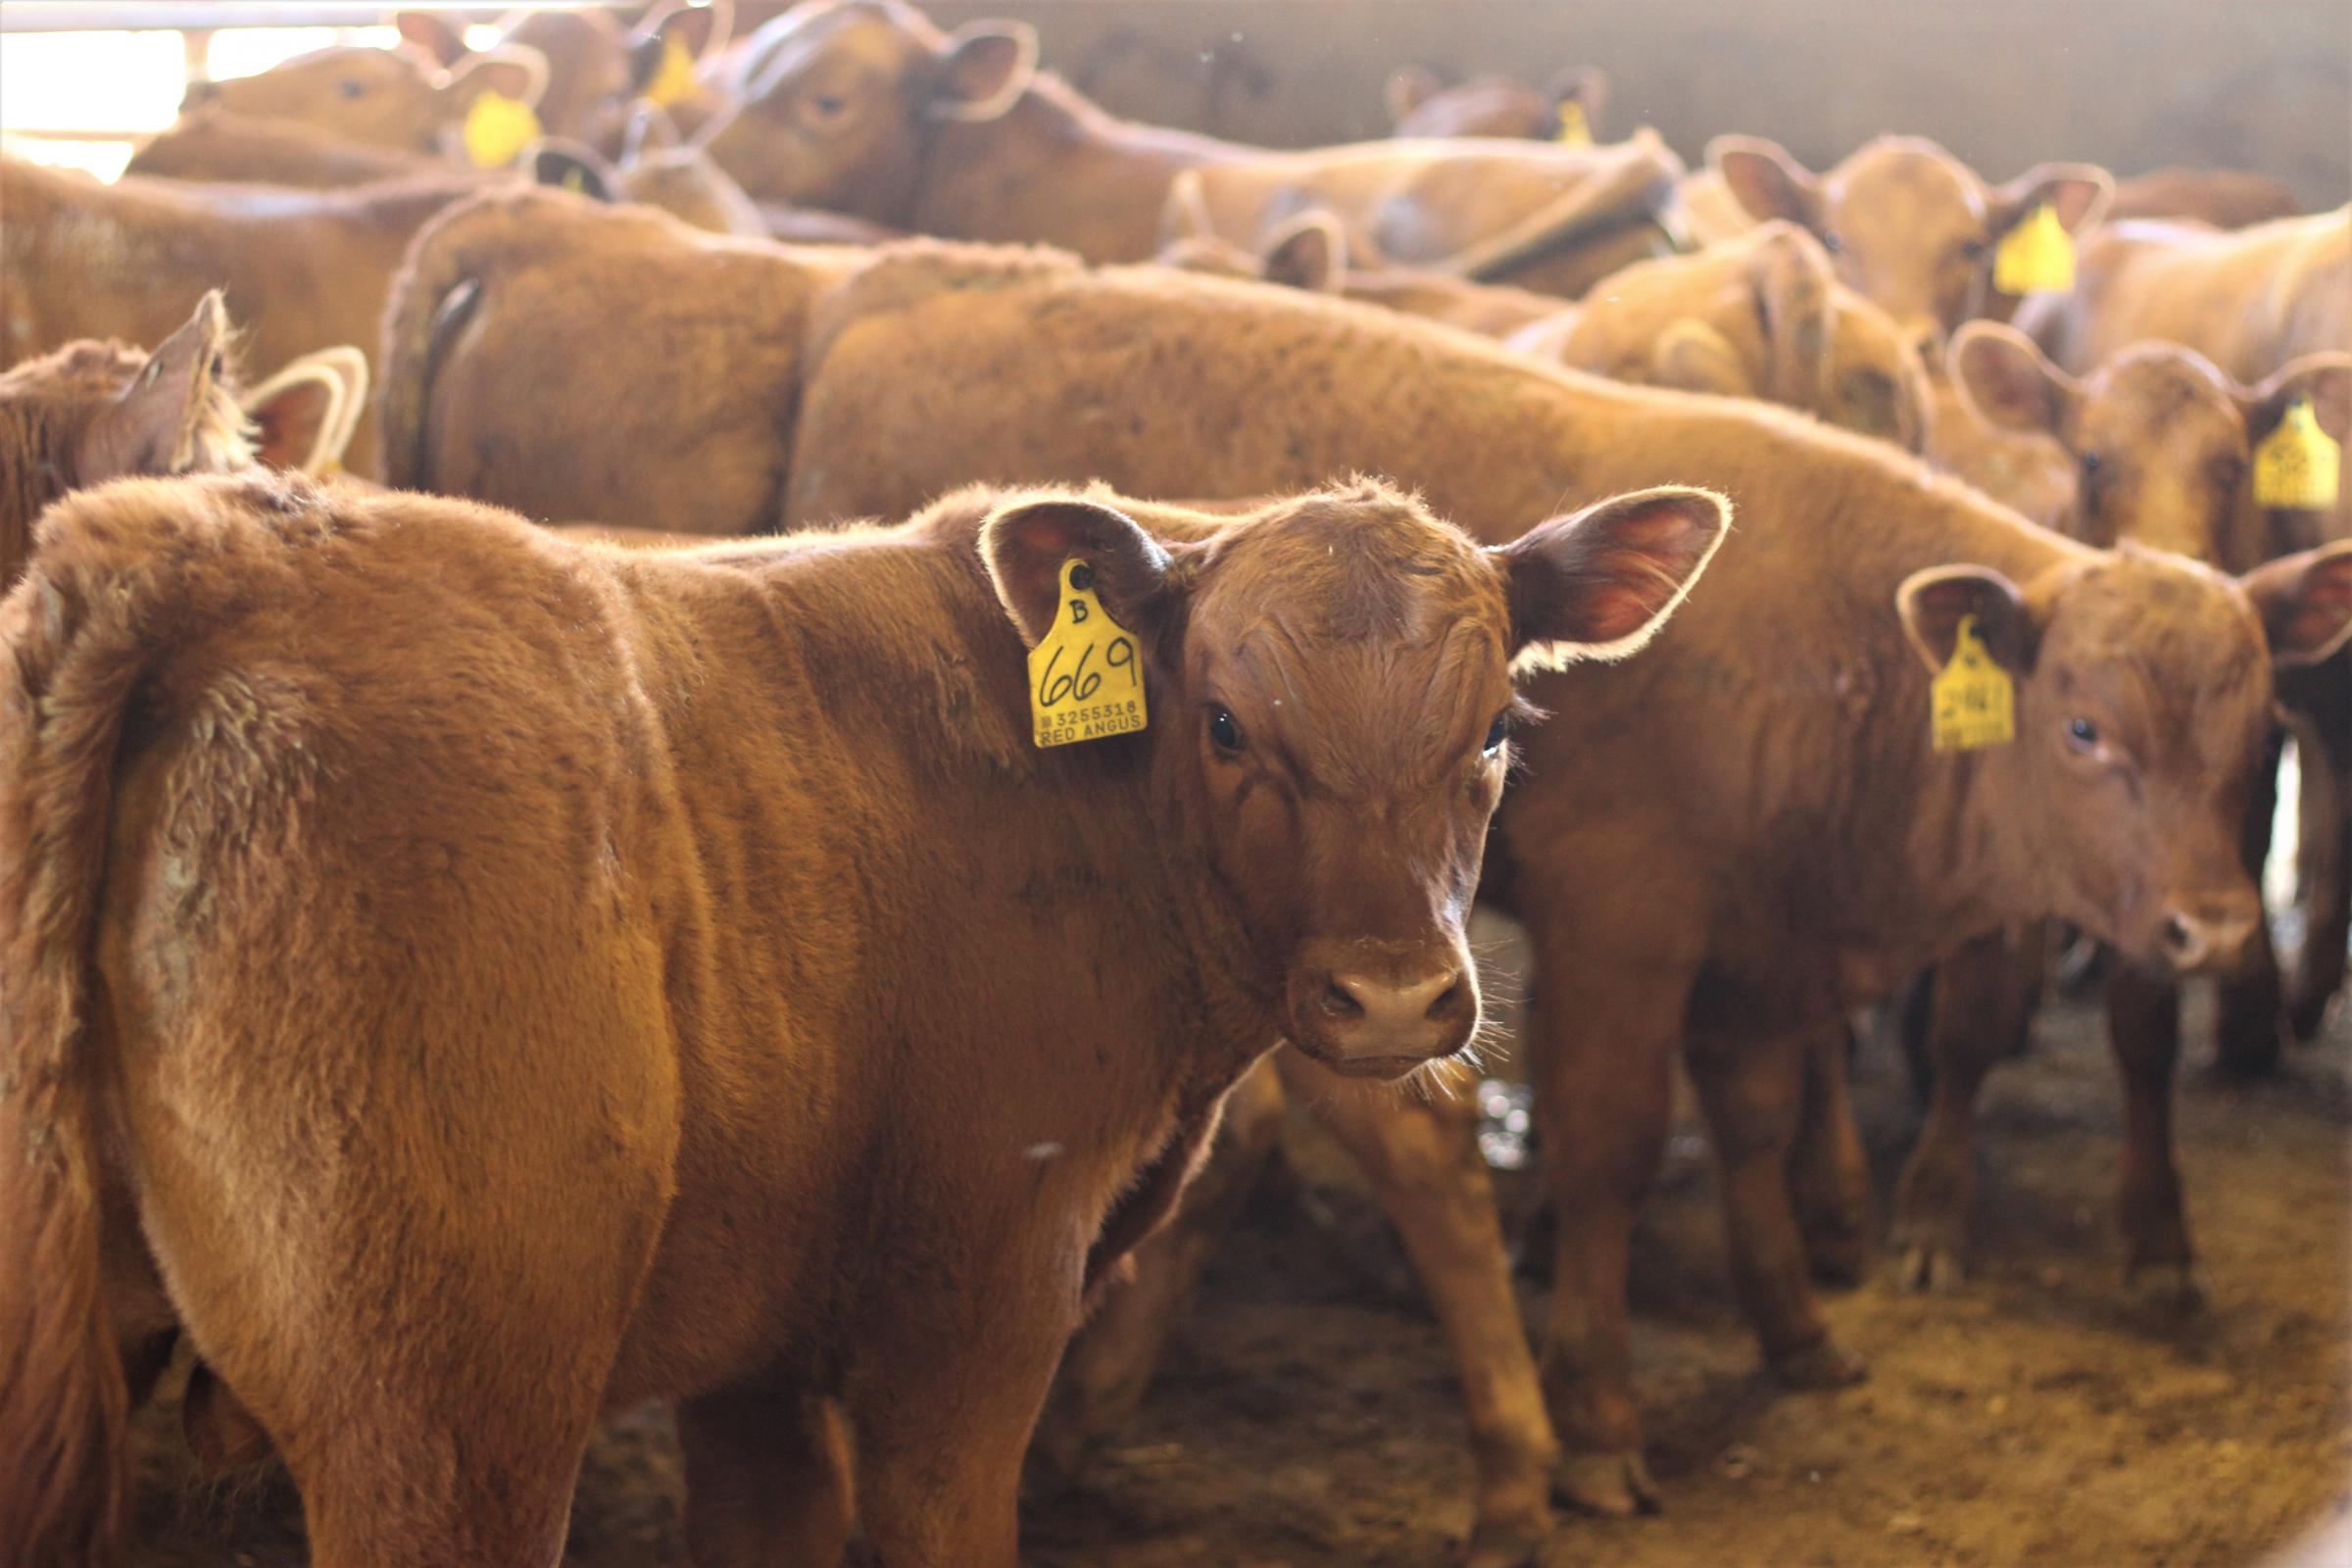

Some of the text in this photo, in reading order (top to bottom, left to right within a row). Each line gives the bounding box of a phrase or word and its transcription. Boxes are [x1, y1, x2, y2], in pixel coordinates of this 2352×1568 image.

[1040, 636, 1137, 708] 669
[1056, 700, 1137, 726] 3255318
[1040, 714, 1141, 746] RED ANGUS
